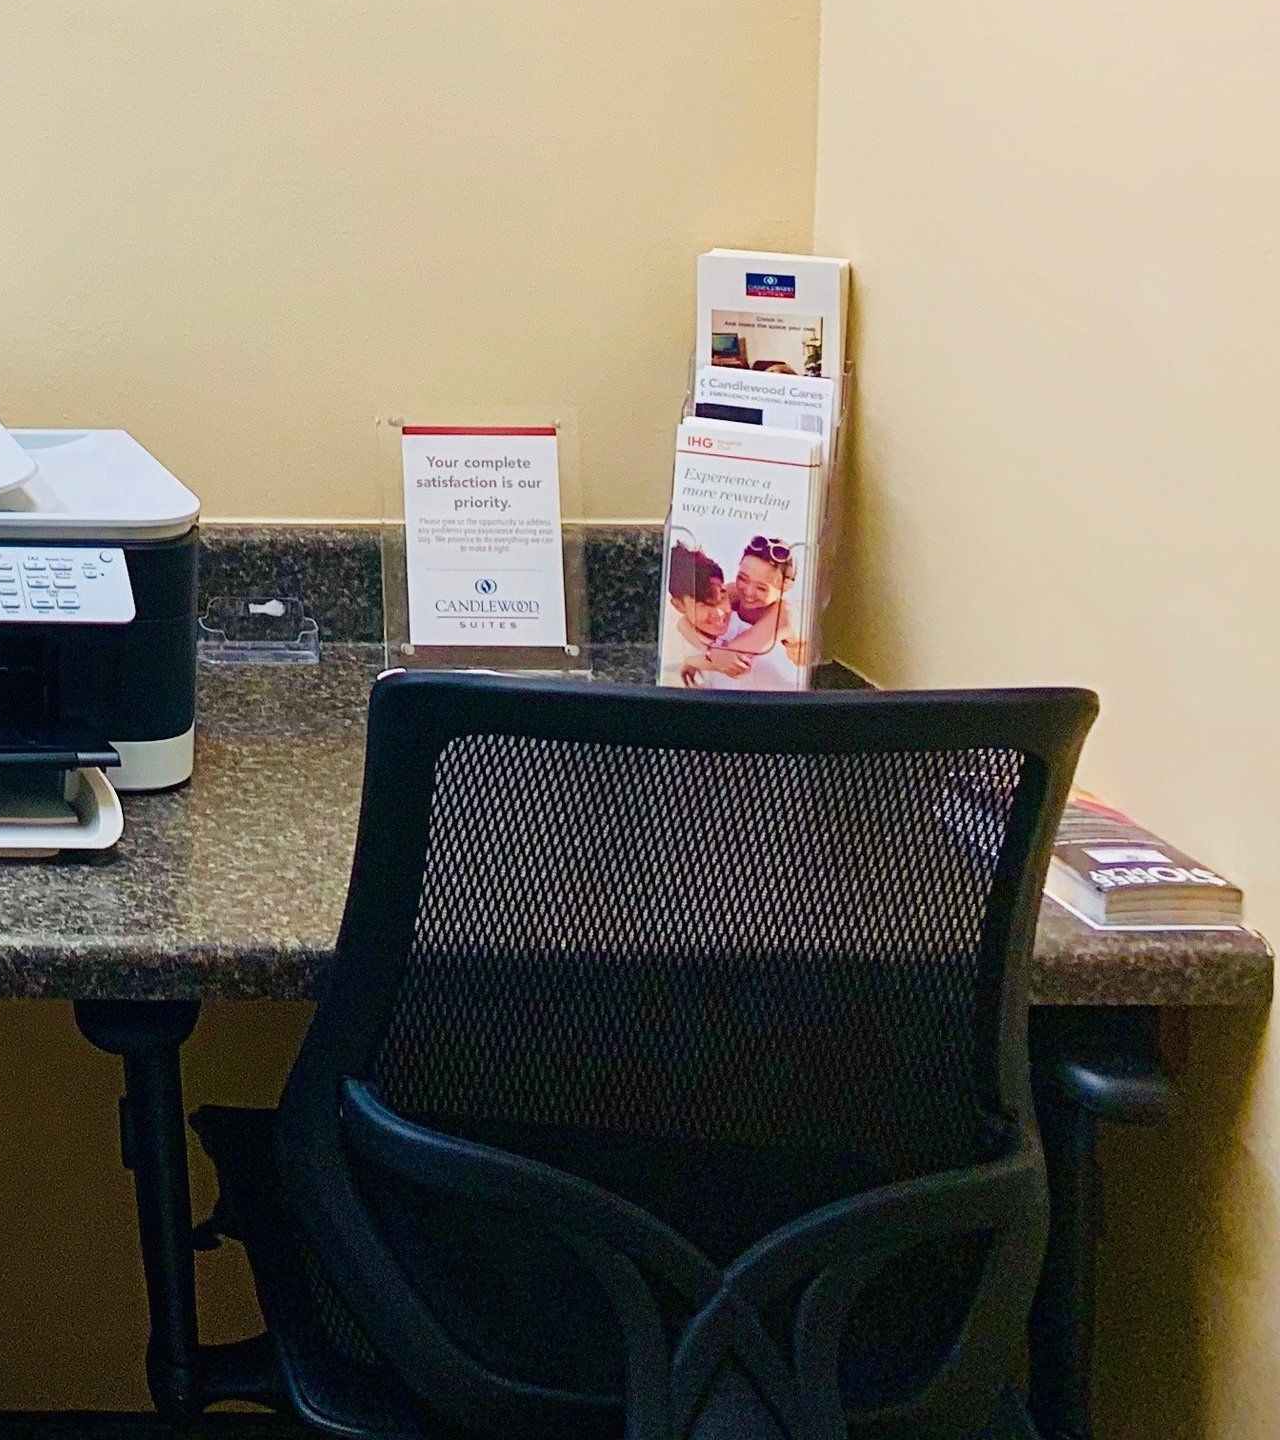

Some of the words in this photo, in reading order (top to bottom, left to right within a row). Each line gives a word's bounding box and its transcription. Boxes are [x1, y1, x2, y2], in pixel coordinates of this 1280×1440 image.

[708, 378, 786, 397] Candlewood
[789, 388, 824, 401] Cares
[709, 391, 750, 401] EMERGENCY
[687, 435, 713, 449] IHG
[425, 456, 459, 469] Your
[464, 456, 531, 471] complete
[416, 476, 497, 489] satisfaction
[502, 476, 513, 489] is
[518, 478, 542, 489] our
[684, 467, 760, 489] Experience
[762, 480, 771, 489] a
[454, 495, 511, 512] priority.
[682, 486, 717, 499] more
[719, 489, 790, 510] rewarding
[682, 503, 709, 517] way
[711, 505, 725, 518] to
[727, 507, 769, 522] travel
[435, 599, 540, 614] CANDLEWOOD
[459, 620, 517, 630] SUITES
